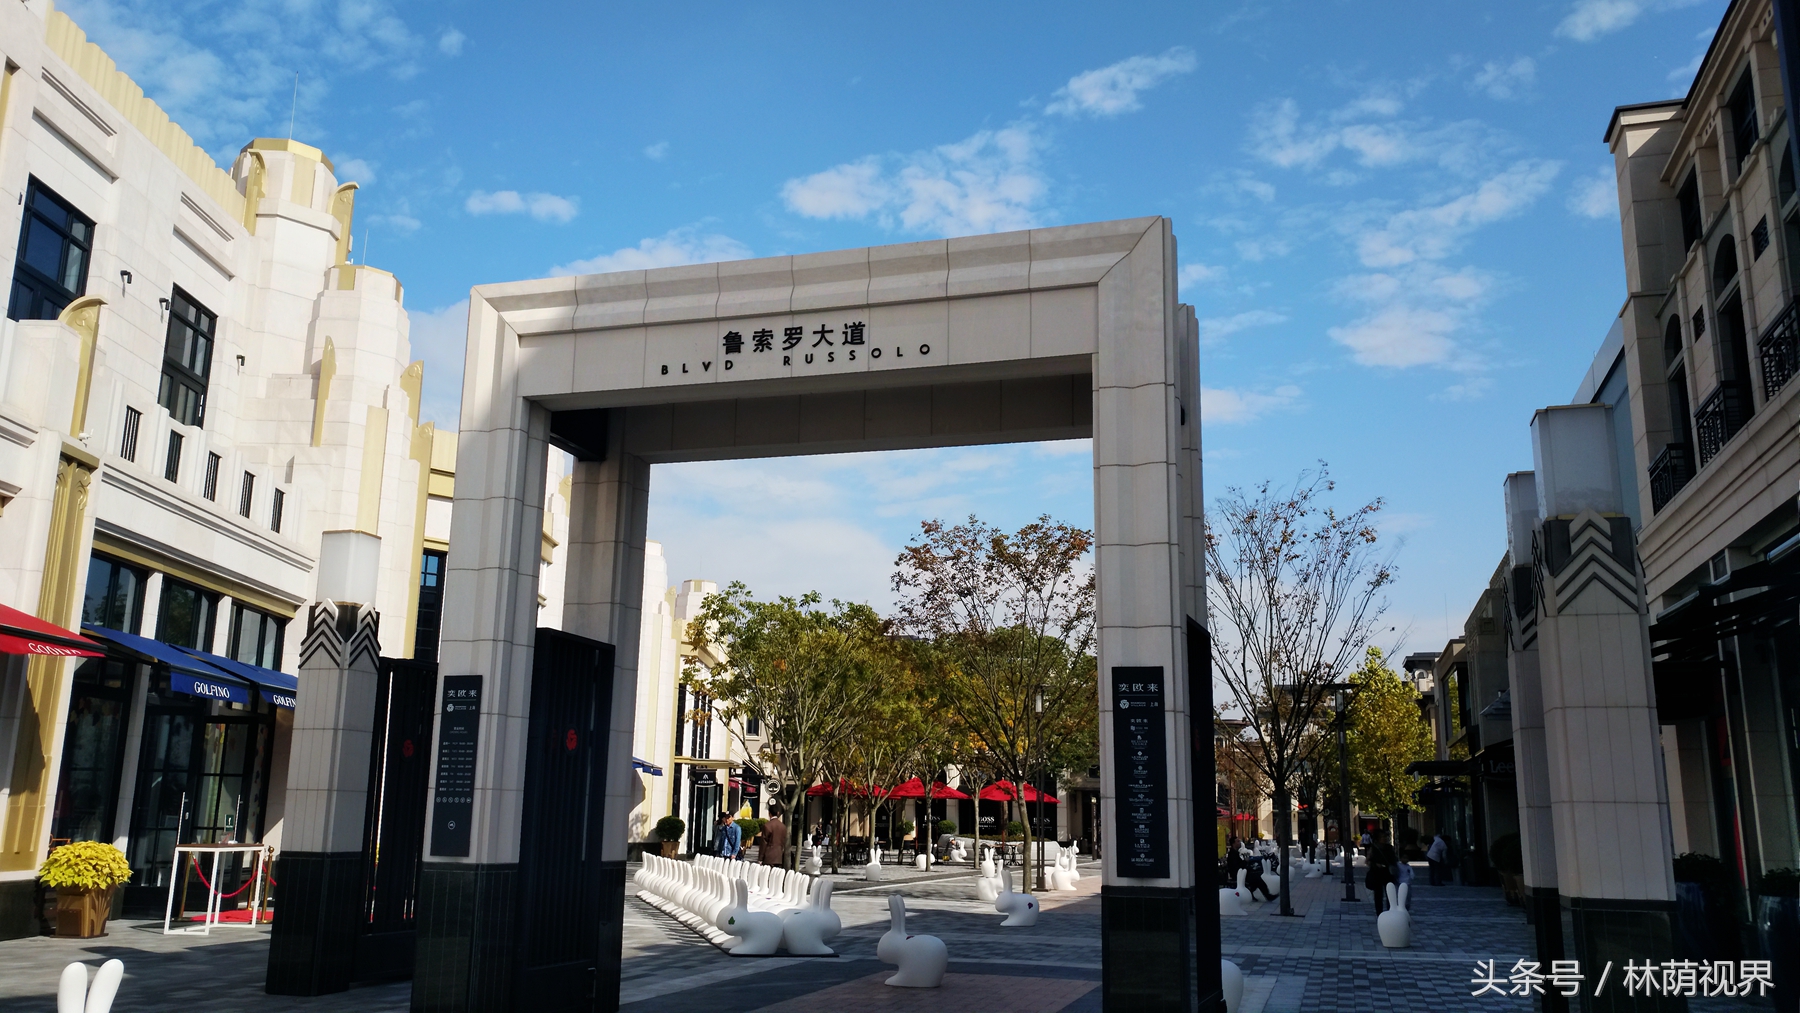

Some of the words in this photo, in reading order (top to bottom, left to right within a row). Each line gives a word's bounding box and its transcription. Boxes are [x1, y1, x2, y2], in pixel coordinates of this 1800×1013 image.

[722, 321, 866, 355] 鲁索罗大道
[661, 360, 734, 375] BLVD
[783, 344, 931, 366] RUSSOLO
[194, 681, 230, 699] GOLFINO
[447, 689, 477, 697] 奕欧来
[1118, 683, 1159, 692] 奕欧来
[273, 694, 297, 708] GOLFIN
[1489, 759, 1514, 774] Lee
